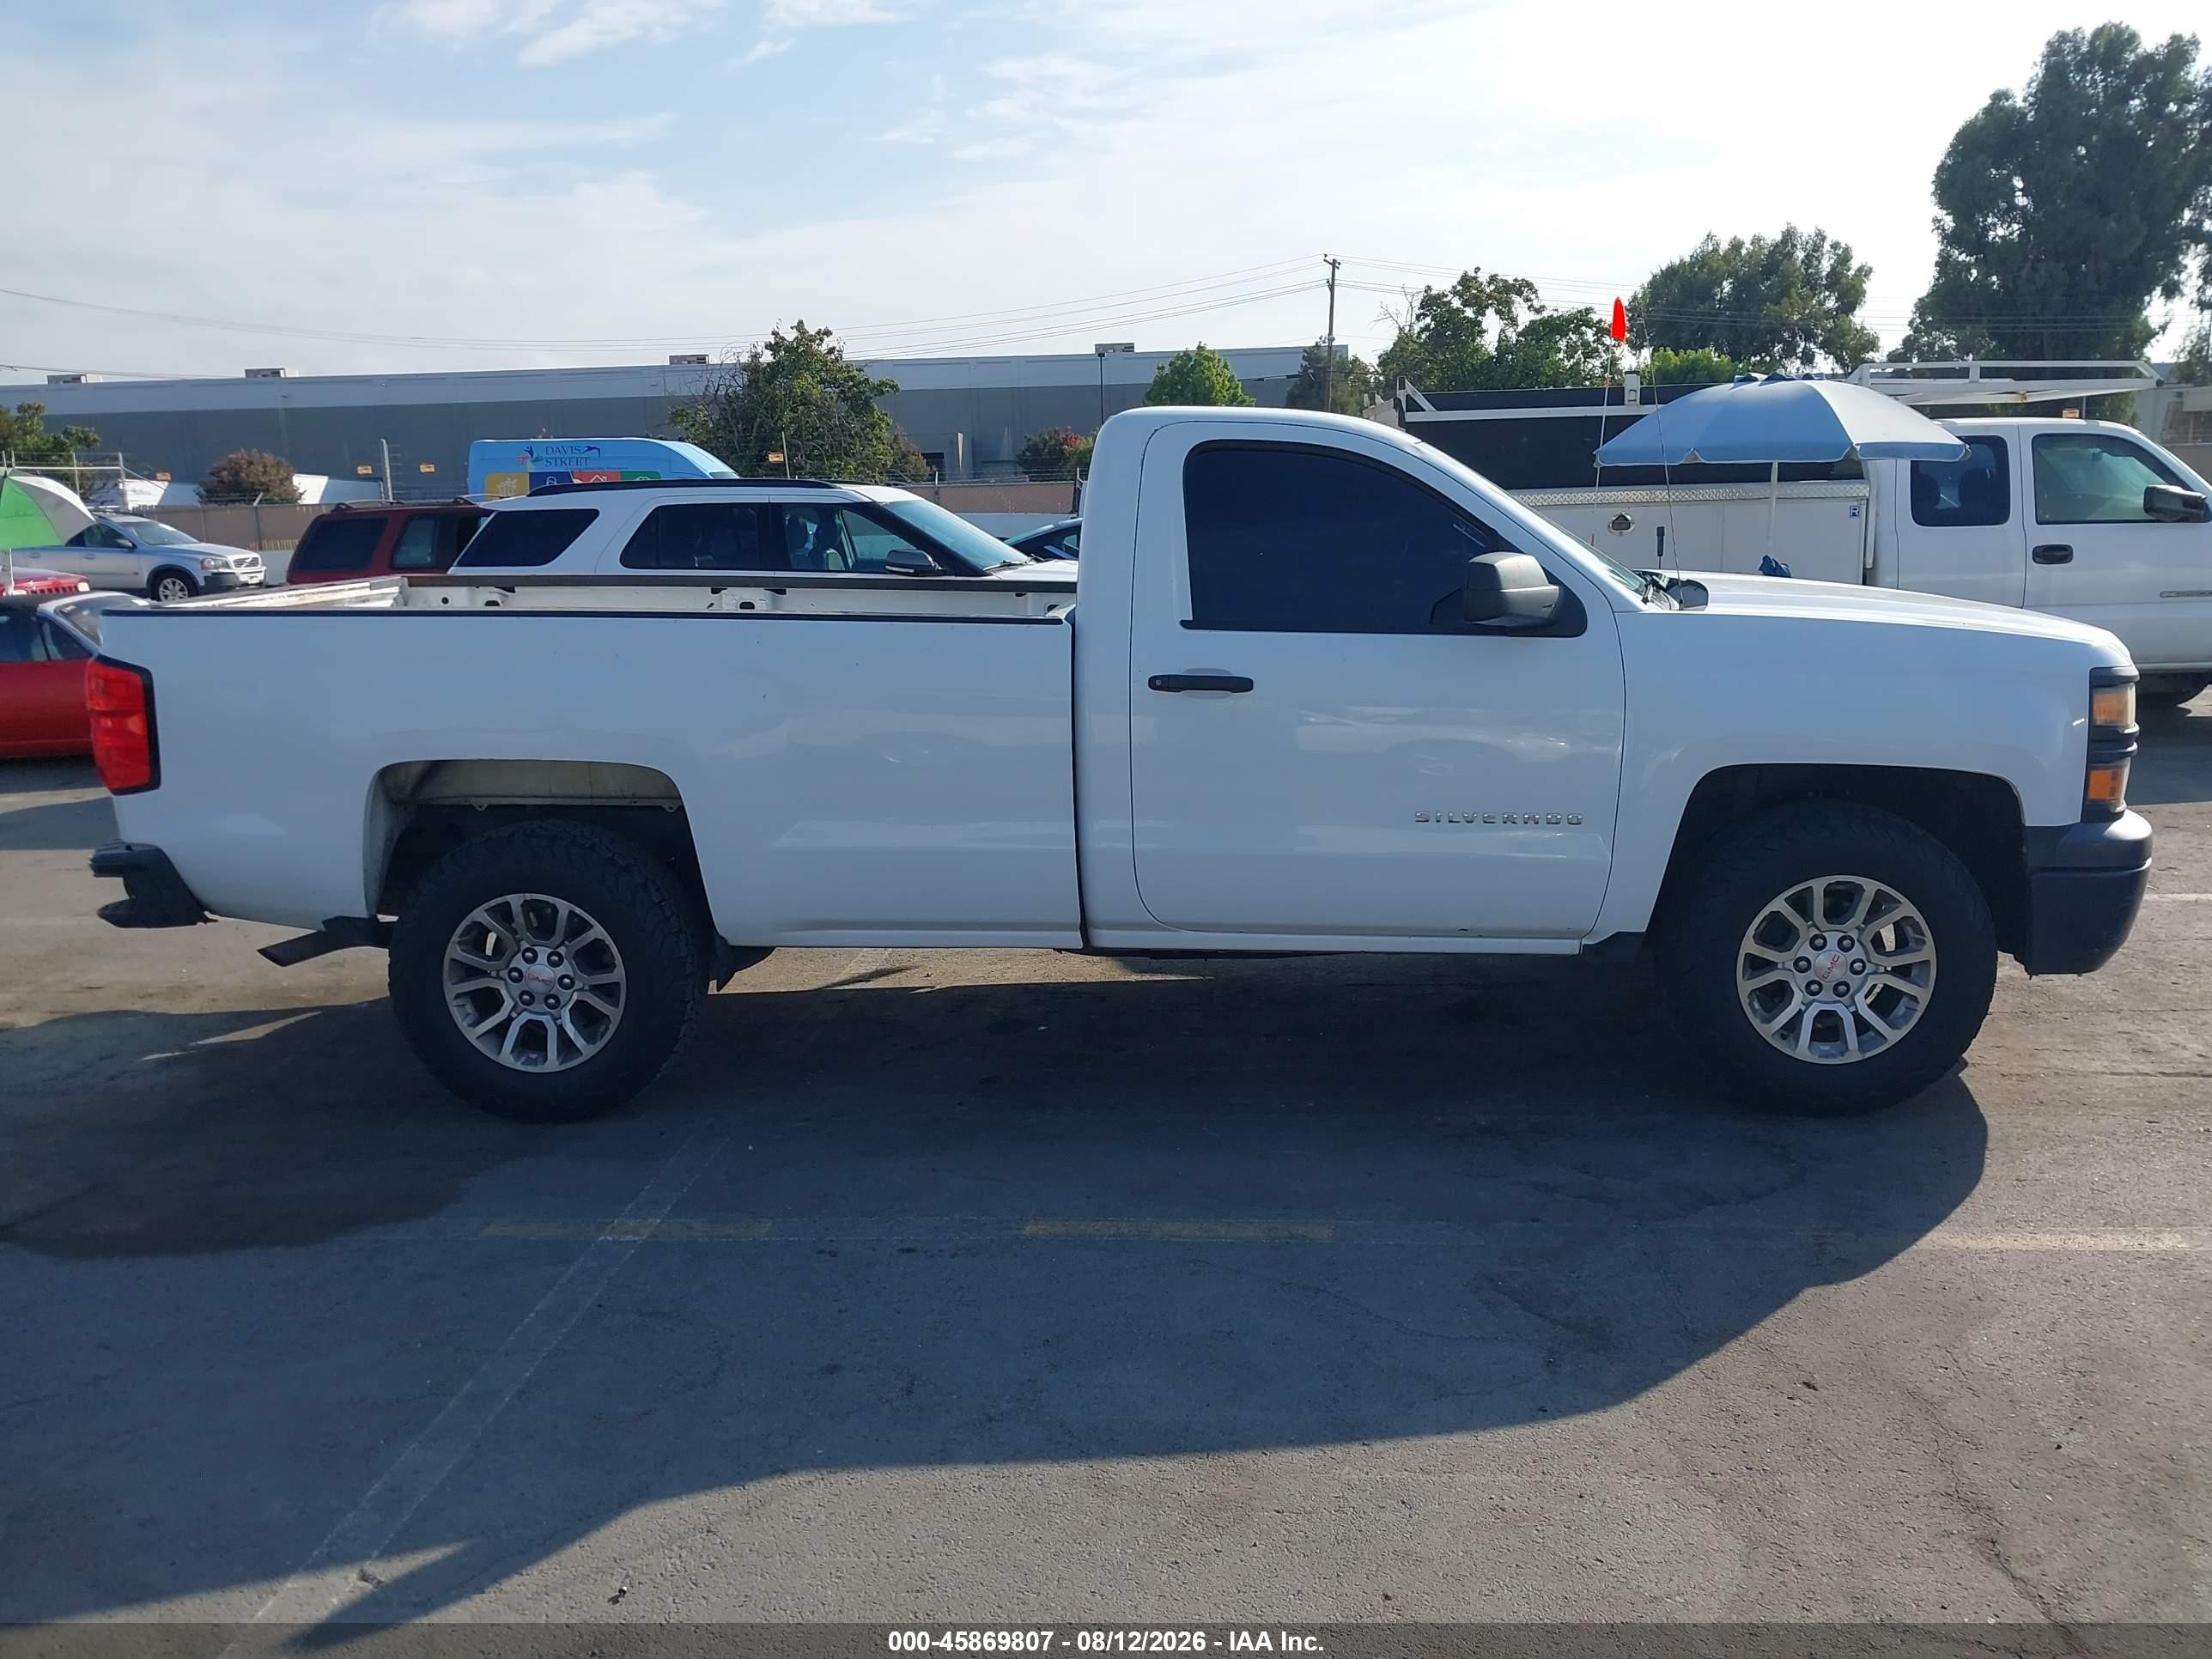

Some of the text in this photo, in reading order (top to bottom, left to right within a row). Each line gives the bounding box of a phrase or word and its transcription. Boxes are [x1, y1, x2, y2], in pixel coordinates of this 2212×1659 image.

[545, 446, 581, 455] DAVIS
[545, 457, 590, 467] STREET
[1414, 811, 1583, 825] SILVERADO
[1821, 954, 1840, 979] GMC
